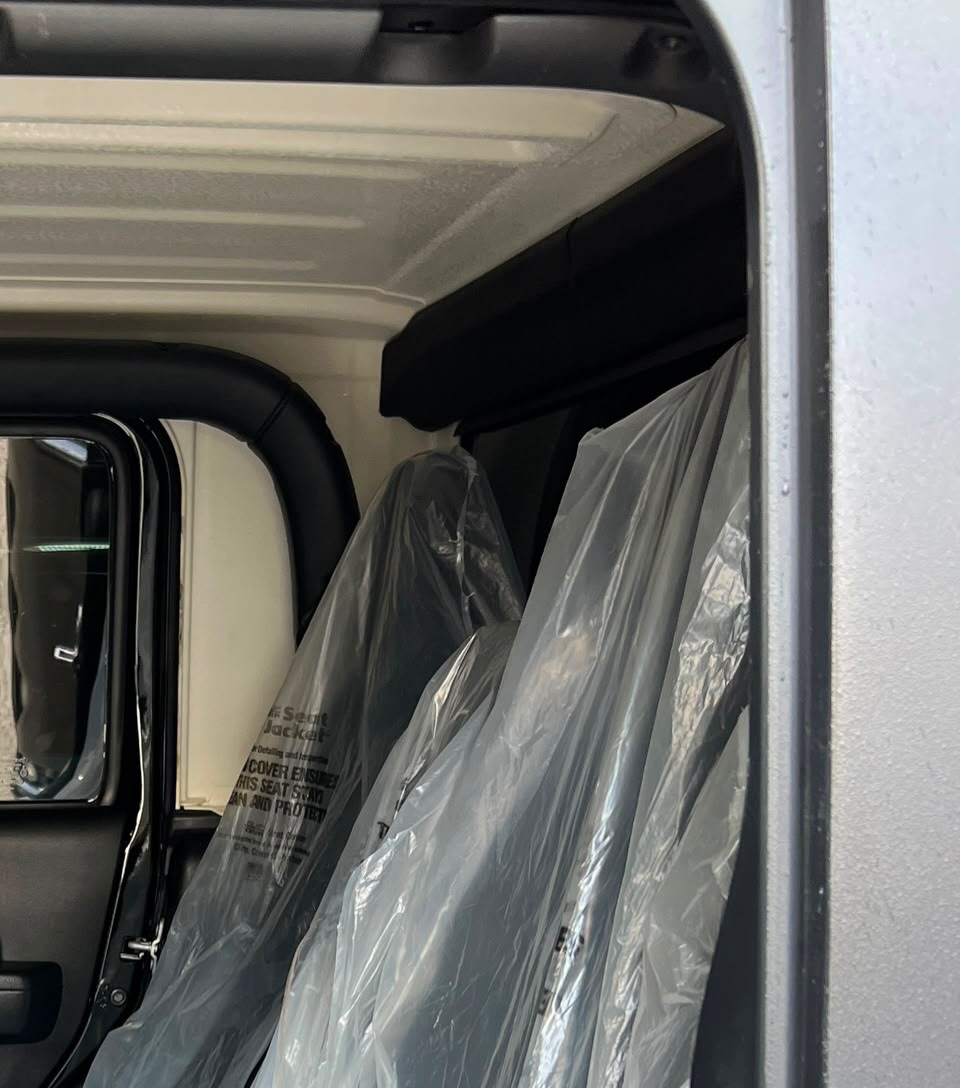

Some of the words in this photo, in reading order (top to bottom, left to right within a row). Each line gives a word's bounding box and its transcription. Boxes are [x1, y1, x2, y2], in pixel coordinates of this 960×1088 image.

[283, 706, 328, 728] Seat
[264, 719, 324, 743] Jacket
[248, 759, 289, 779] COVER
[260, 778, 289, 797] SEAT
[249, 794, 272, 812] AND
